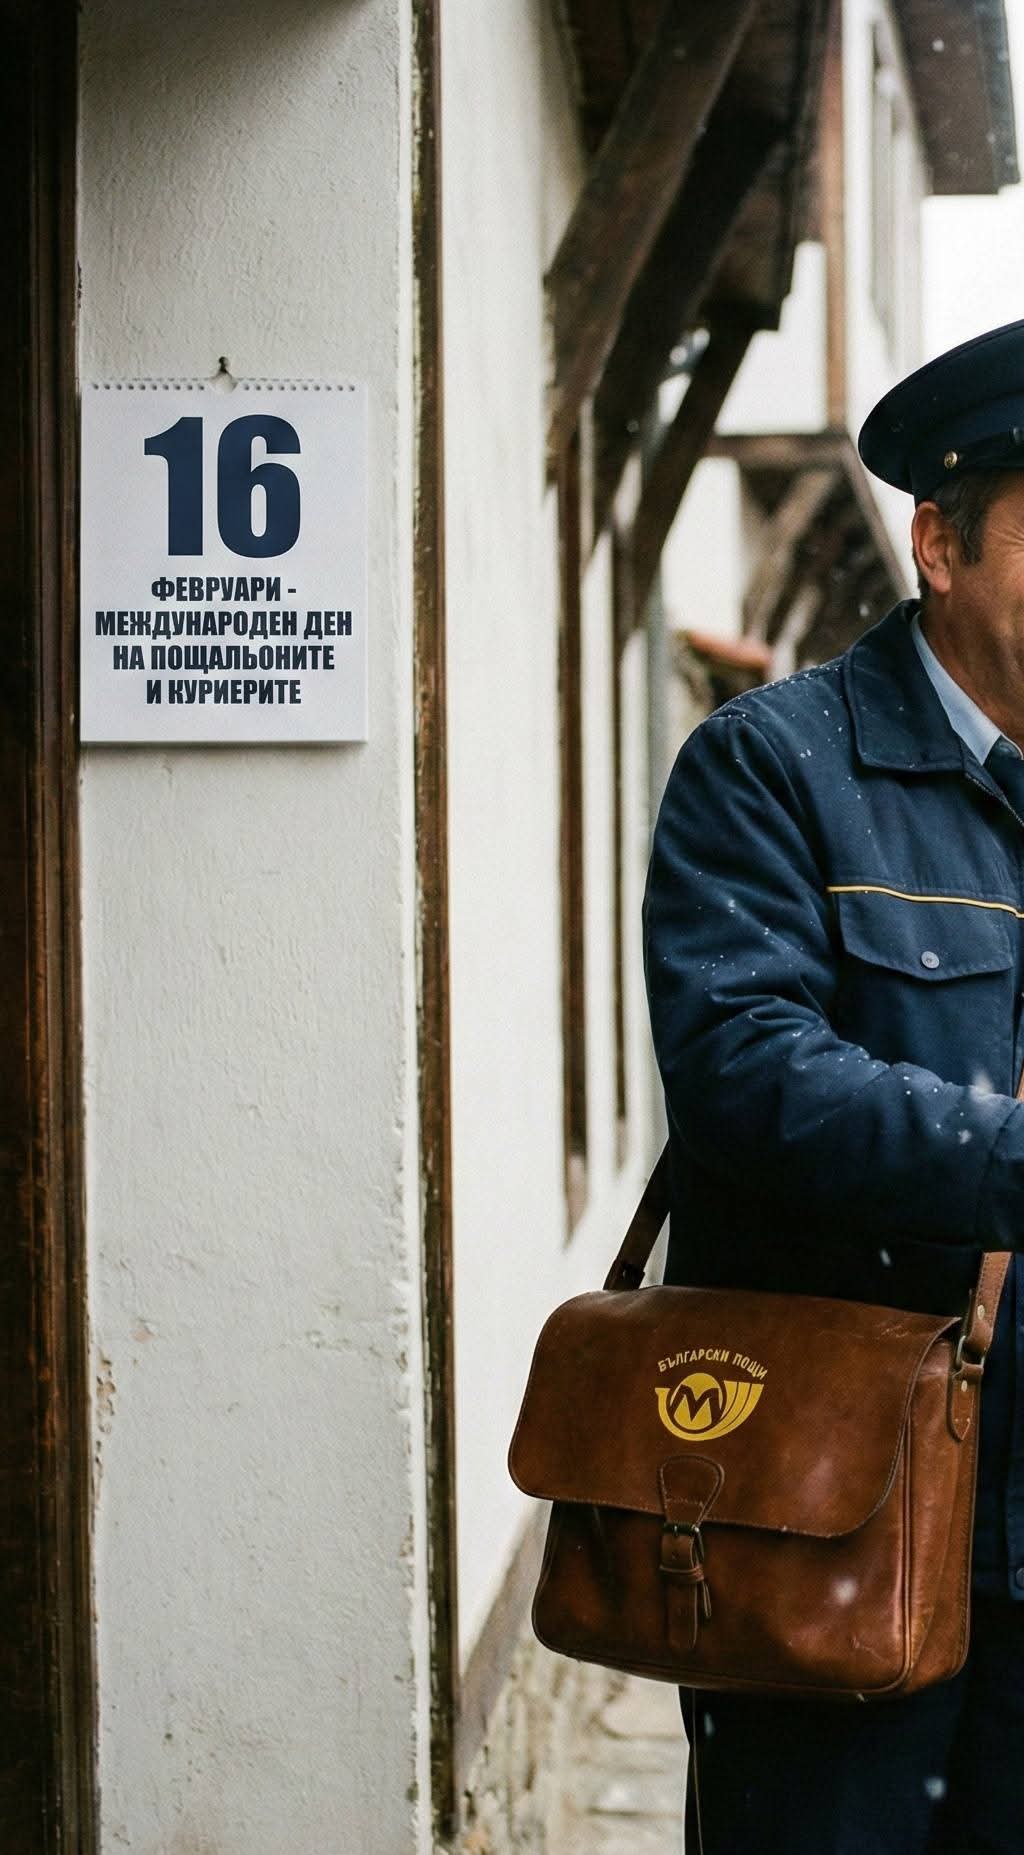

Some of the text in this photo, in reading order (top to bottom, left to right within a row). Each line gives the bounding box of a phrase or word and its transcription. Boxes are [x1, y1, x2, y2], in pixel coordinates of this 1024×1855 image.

[144, 414, 301, 559] 16
[151, 577, 281, 602] ФЕВРУАРИ
[95, 611, 353, 640] МЕЖДУНАРОДЕН ДЕН
[113, 645, 335, 674] НА ПОЩАЛЬОНИТЕ
[146, 680, 302, 704] И КУРИЕРИТЕ
[657, 1348, 769, 1380] БЪЛГАРСКИ ПОЩИ
